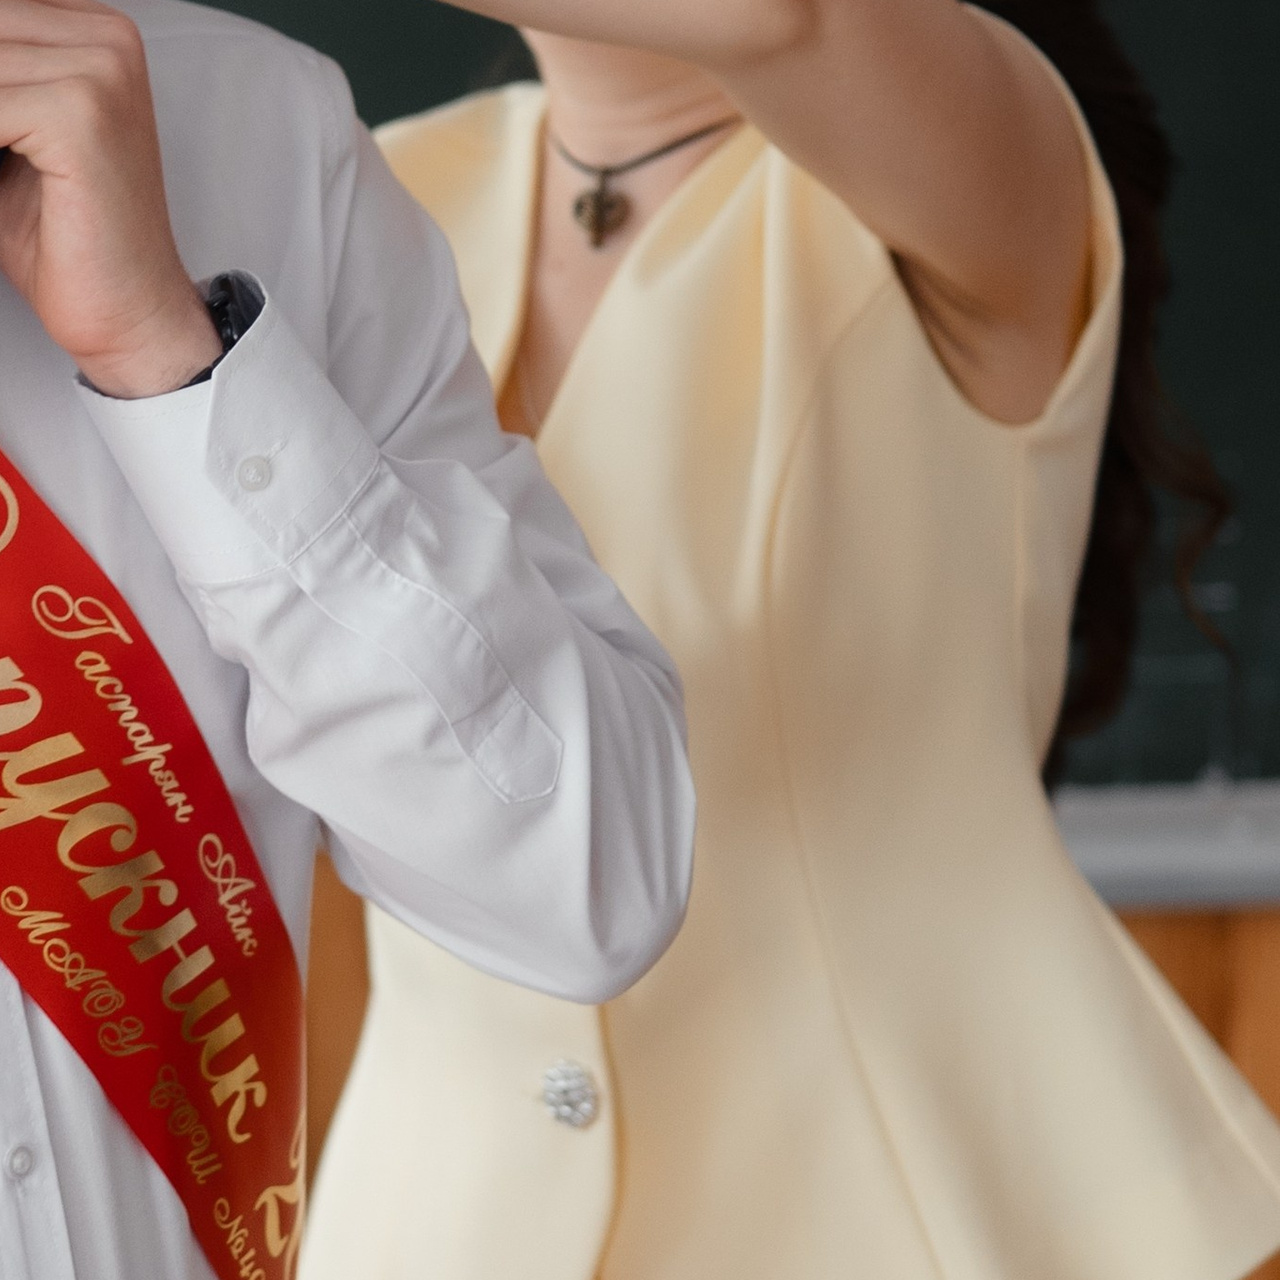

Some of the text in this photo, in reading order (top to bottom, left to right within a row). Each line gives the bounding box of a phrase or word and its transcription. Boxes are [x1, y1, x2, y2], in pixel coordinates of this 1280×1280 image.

[31, 584, 260, 958] Гаспарян Айк
[0, 885, 159, 1057] МАОУ
